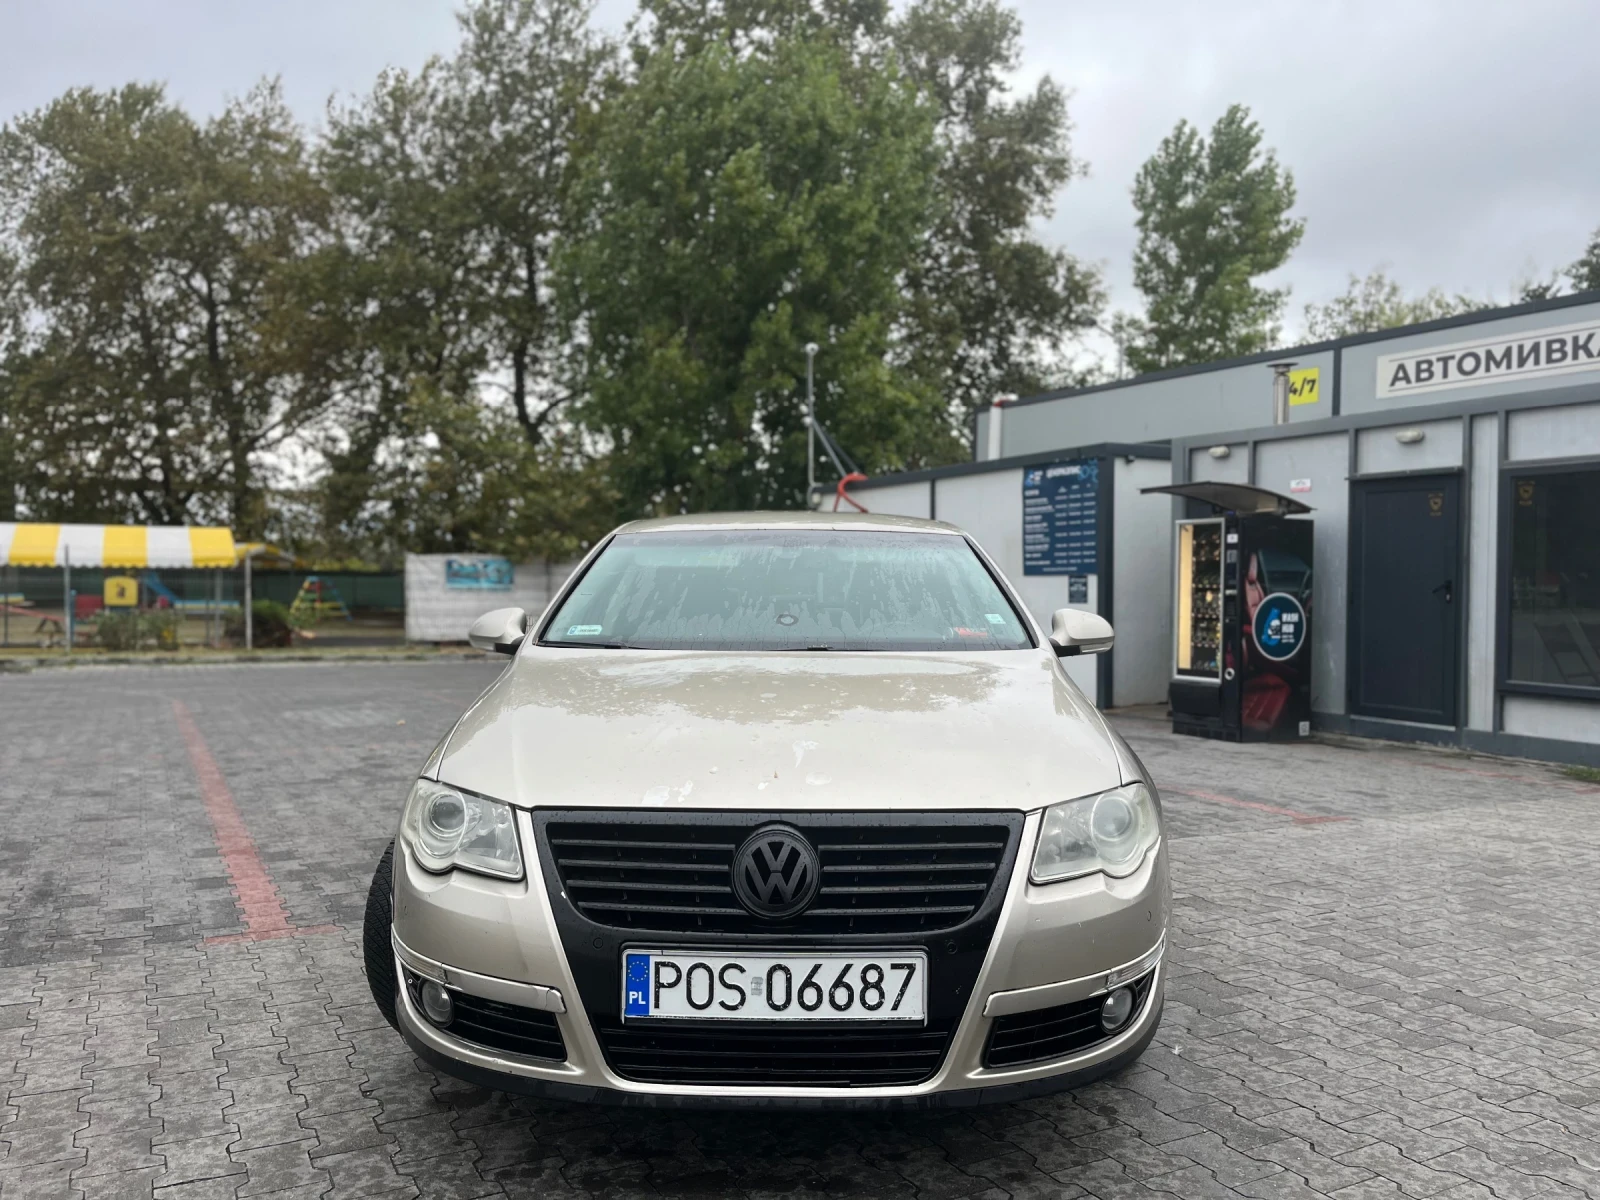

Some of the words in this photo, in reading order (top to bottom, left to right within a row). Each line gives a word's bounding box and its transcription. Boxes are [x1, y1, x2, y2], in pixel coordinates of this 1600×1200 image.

[1289, 377, 1317, 397] 4/7
[738, 837, 813, 907] VW
[629, 991, 646, 1005] PL
[654, 960, 747, 1011] POS
[766, 963, 917, 1012] 06687
